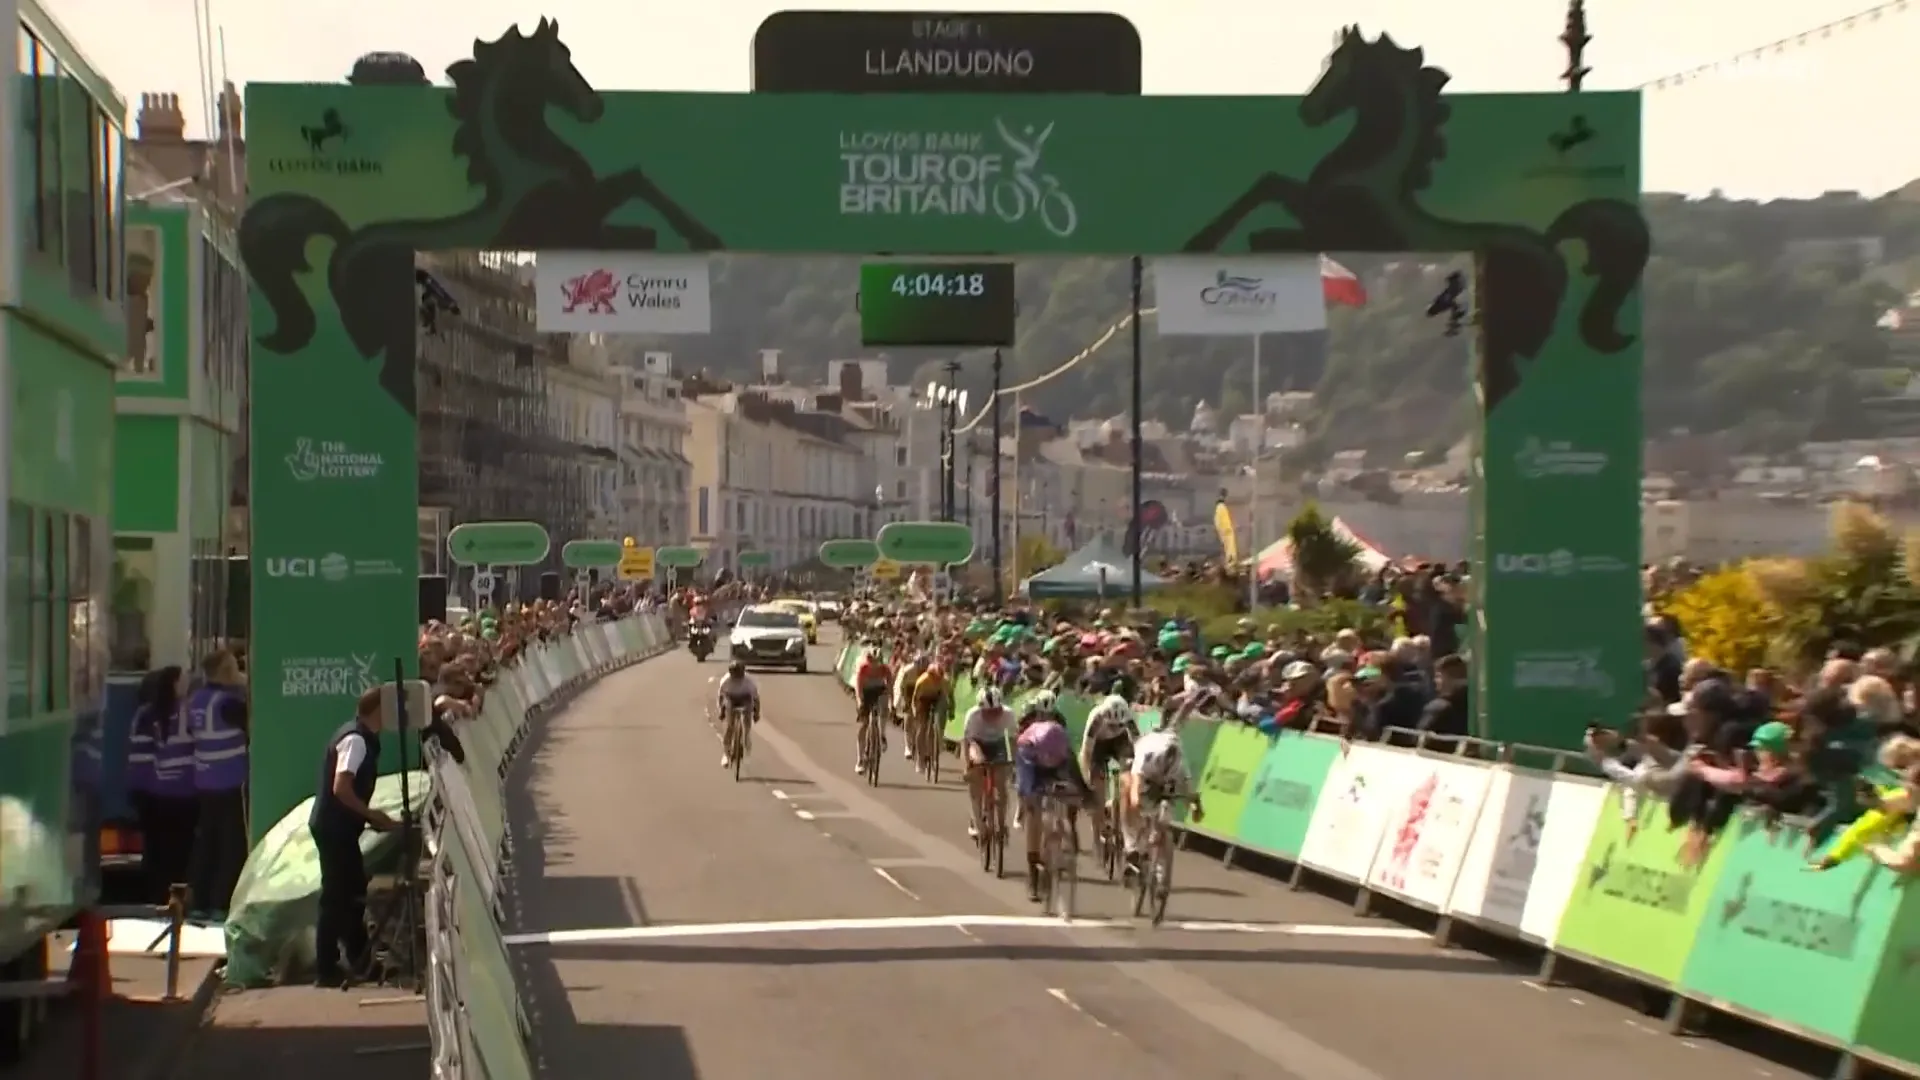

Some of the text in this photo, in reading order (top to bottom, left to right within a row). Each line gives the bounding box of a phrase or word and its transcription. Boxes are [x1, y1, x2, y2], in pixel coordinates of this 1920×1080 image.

[865, 49, 1034, 76] LLANDUDNO
[839, 130, 983, 152] LLOYDS BANK
[840, 154, 1003, 184] TOUR OF
[840, 183, 986, 215] BRITAIN
[626, 273, 688, 291] Cymru
[891, 272, 985, 297] 4:04:18
[627, 292, 682, 309] Wales
[321, 440, 346, 453] THE
[320, 452, 385, 465] NATIONAL
[320, 465, 377, 477] LOTTERY
[266, 557, 316, 578] UCI
[283, 667, 354, 682] TOUR OF
[282, 680, 348, 697] BRITAIN
